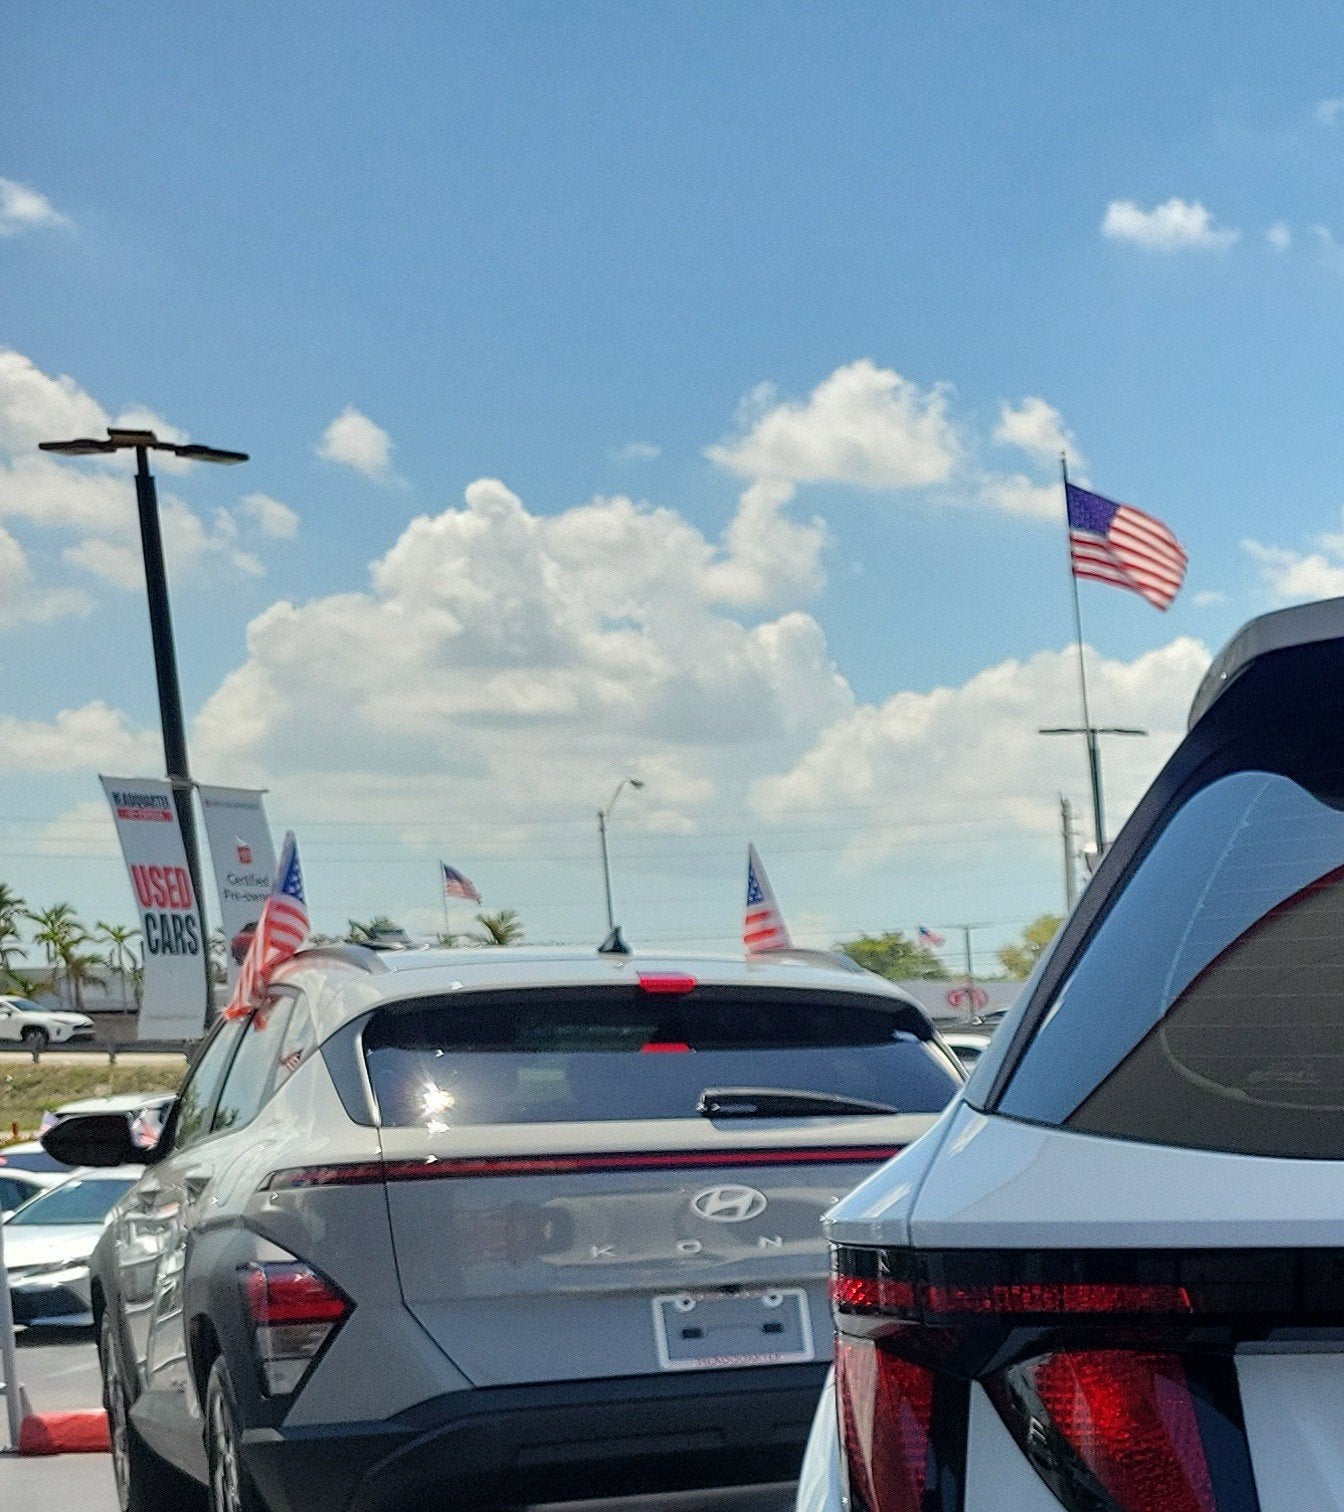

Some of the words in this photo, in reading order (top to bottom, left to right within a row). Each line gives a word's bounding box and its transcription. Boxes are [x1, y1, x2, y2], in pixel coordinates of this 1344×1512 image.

[131, 865, 192, 909] USED
[145, 912, 198, 955] CARS
[590, 1235, 783, 1258] KON
